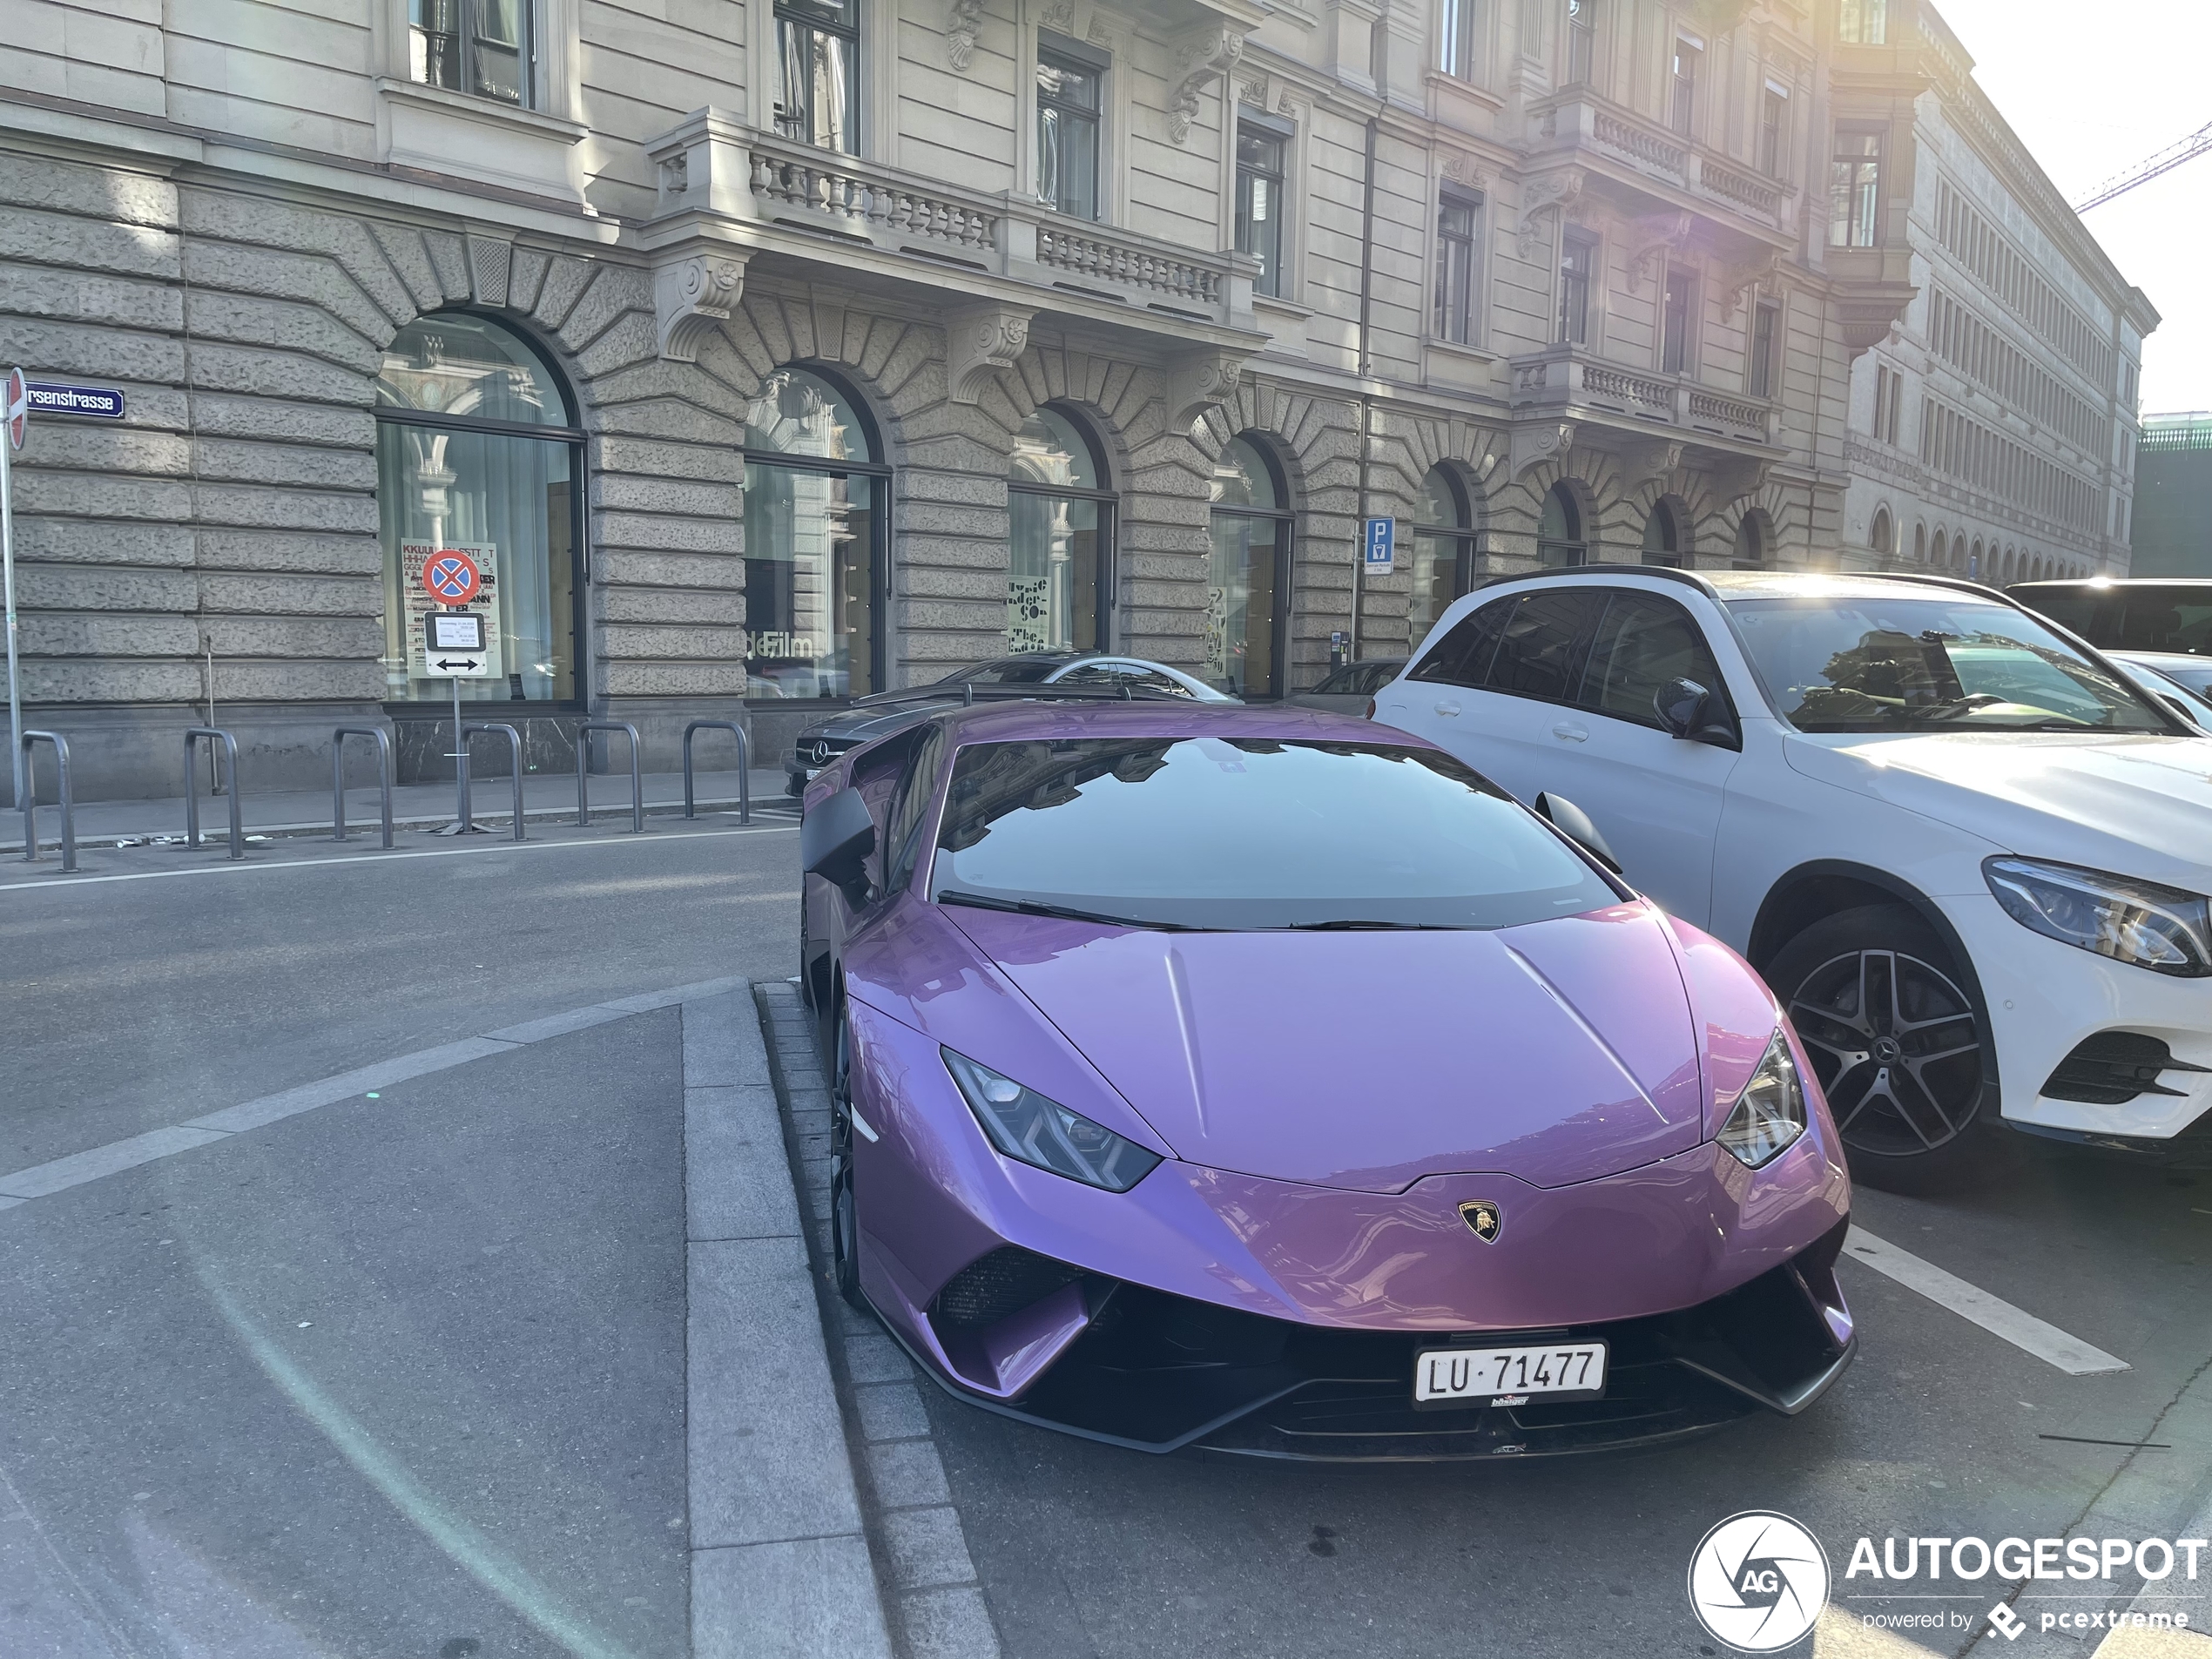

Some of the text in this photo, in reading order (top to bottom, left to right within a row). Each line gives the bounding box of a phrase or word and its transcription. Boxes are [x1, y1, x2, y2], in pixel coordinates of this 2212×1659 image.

[27, 389, 114, 410] rsenstrasse
[1375, 522, 1386, 543] P
[1494, 1352, 1594, 1390] 71477
